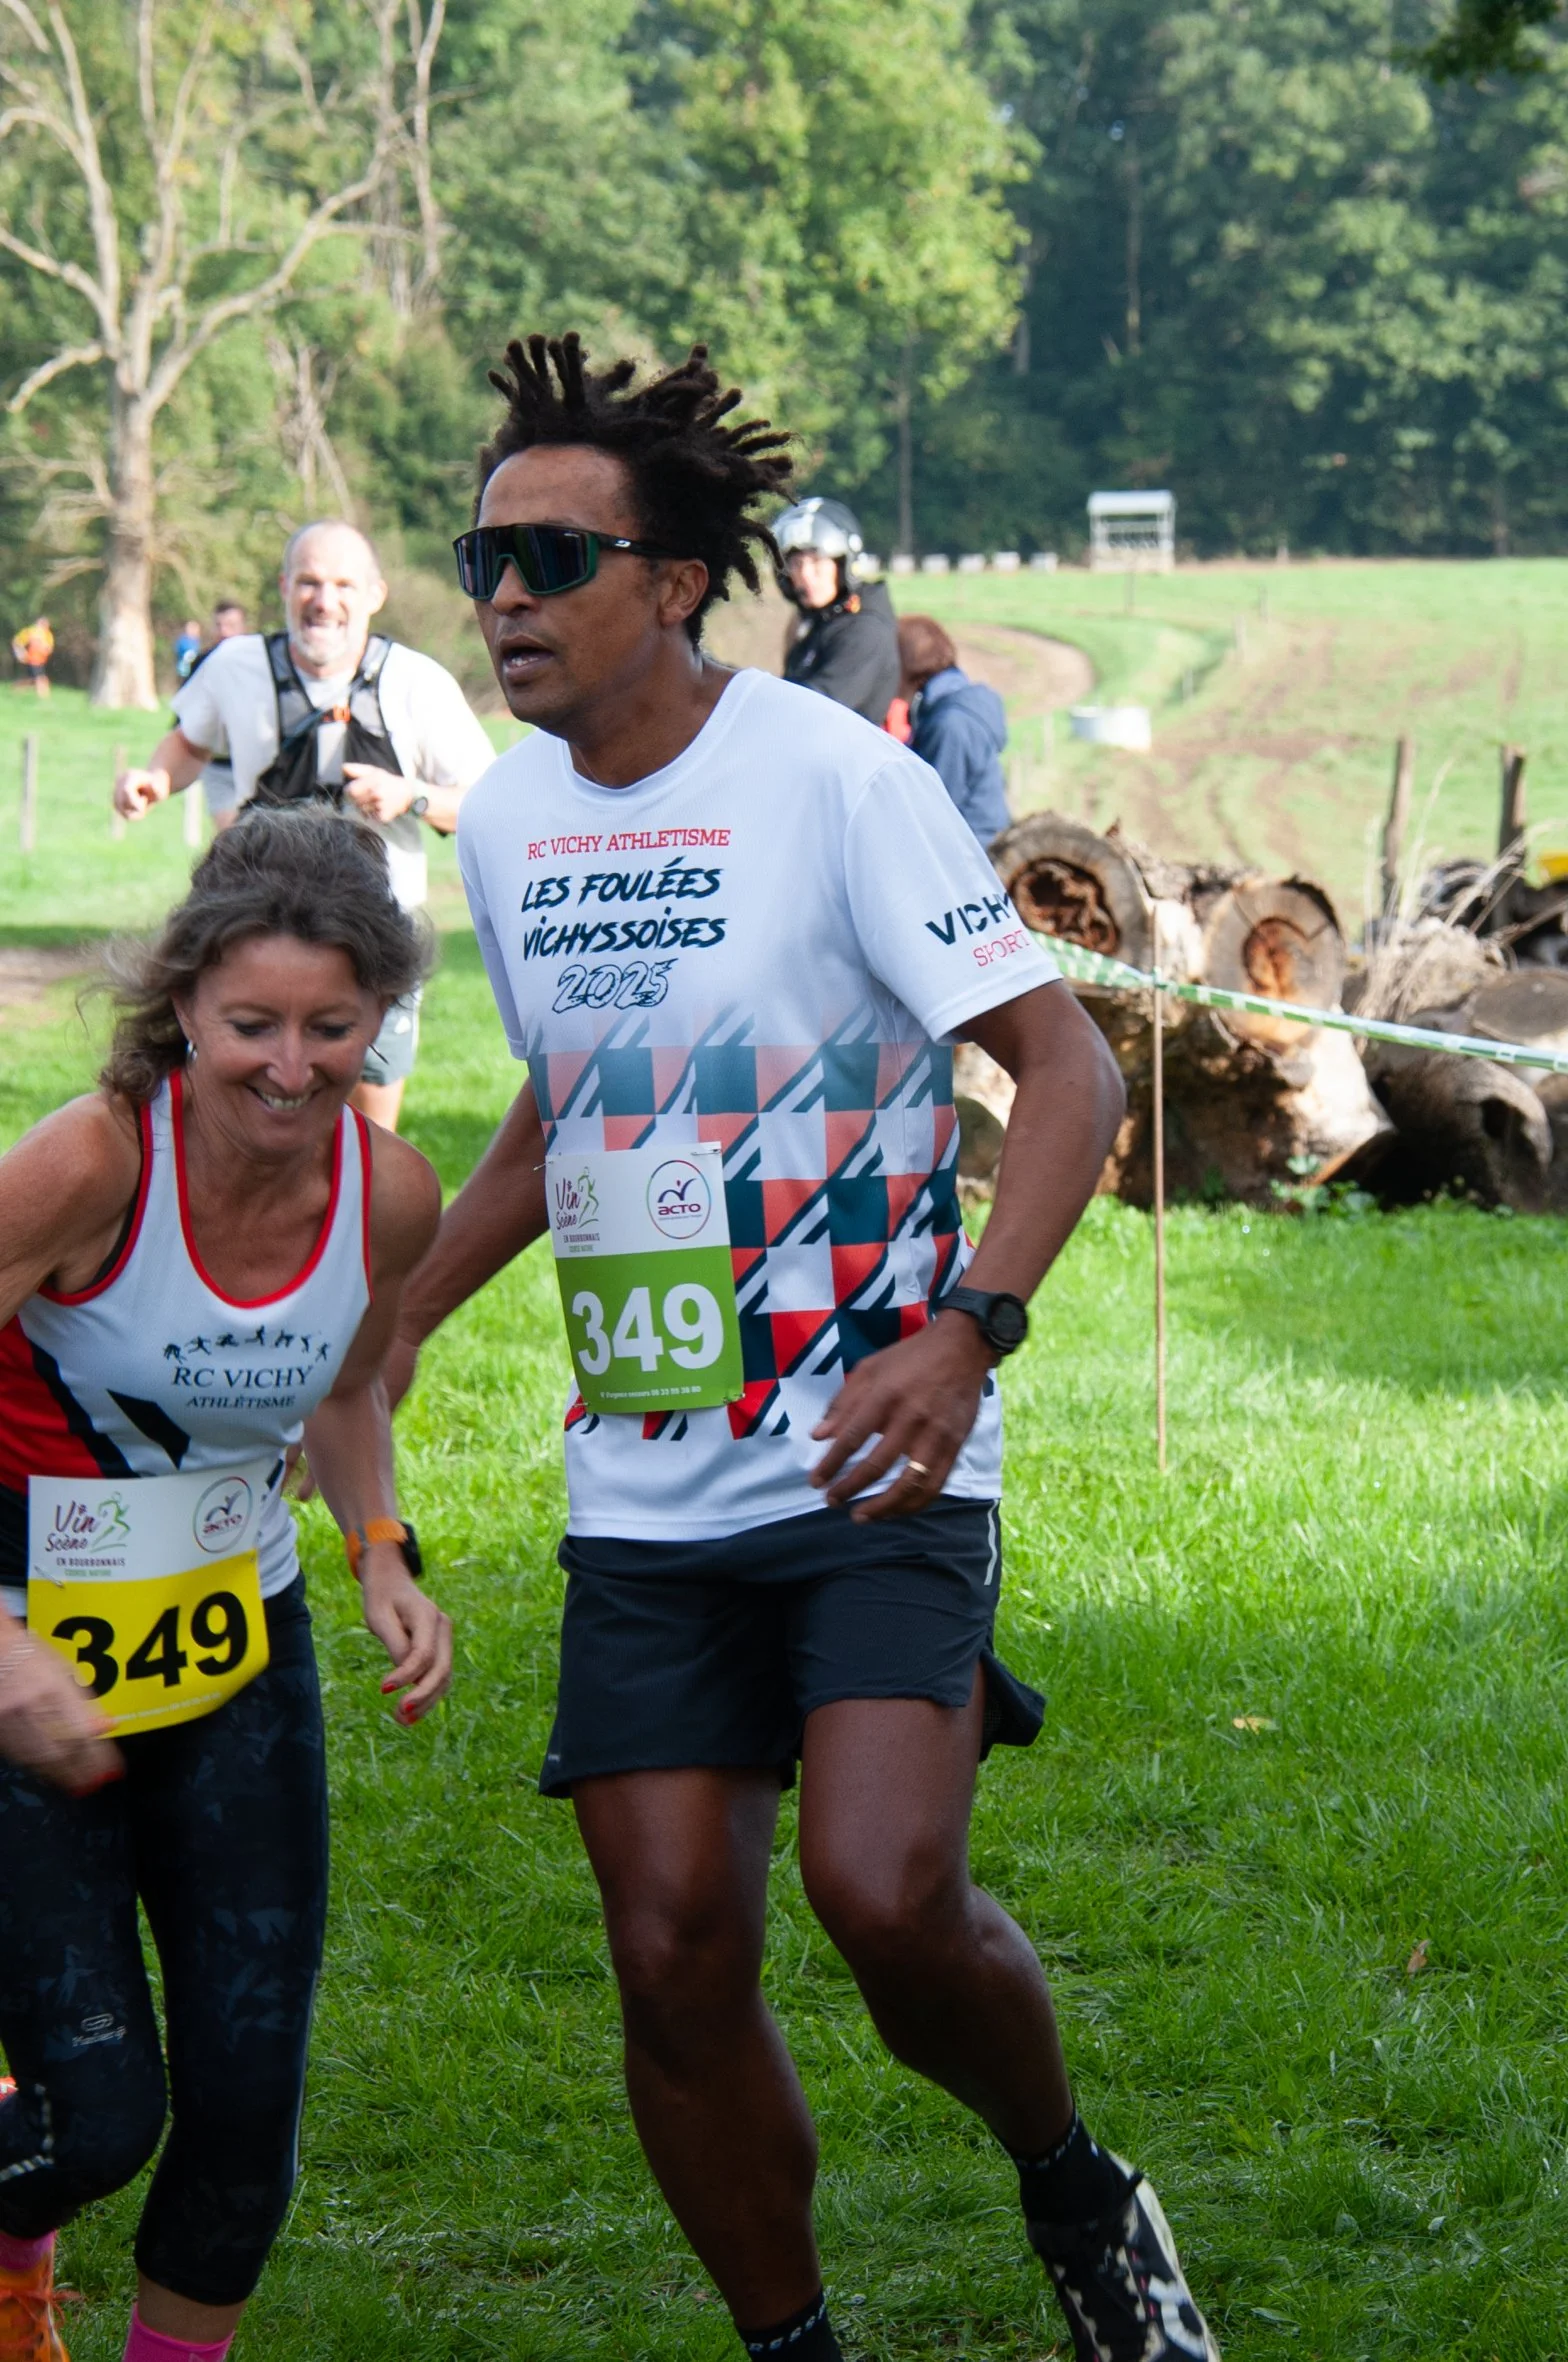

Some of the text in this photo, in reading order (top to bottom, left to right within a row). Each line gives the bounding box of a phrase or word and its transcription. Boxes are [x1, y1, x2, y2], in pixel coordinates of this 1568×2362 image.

[528, 828, 731, 860] RC VICHY ATHLETISME
[521, 856, 724, 912] LES FOULÉES
[523, 906, 730, 961] VICHYSSOISES
[973, 930, 1030, 967] SPORT
[552, 958, 679, 1014] 2025
[556, 1177, 581, 1210] Vin
[572, 1283, 724, 1376] 349
[171, 1365, 313, 1388] RC VICHY
[56, 1500, 97, 1533] Vin
[51, 1591, 249, 1699] 349
